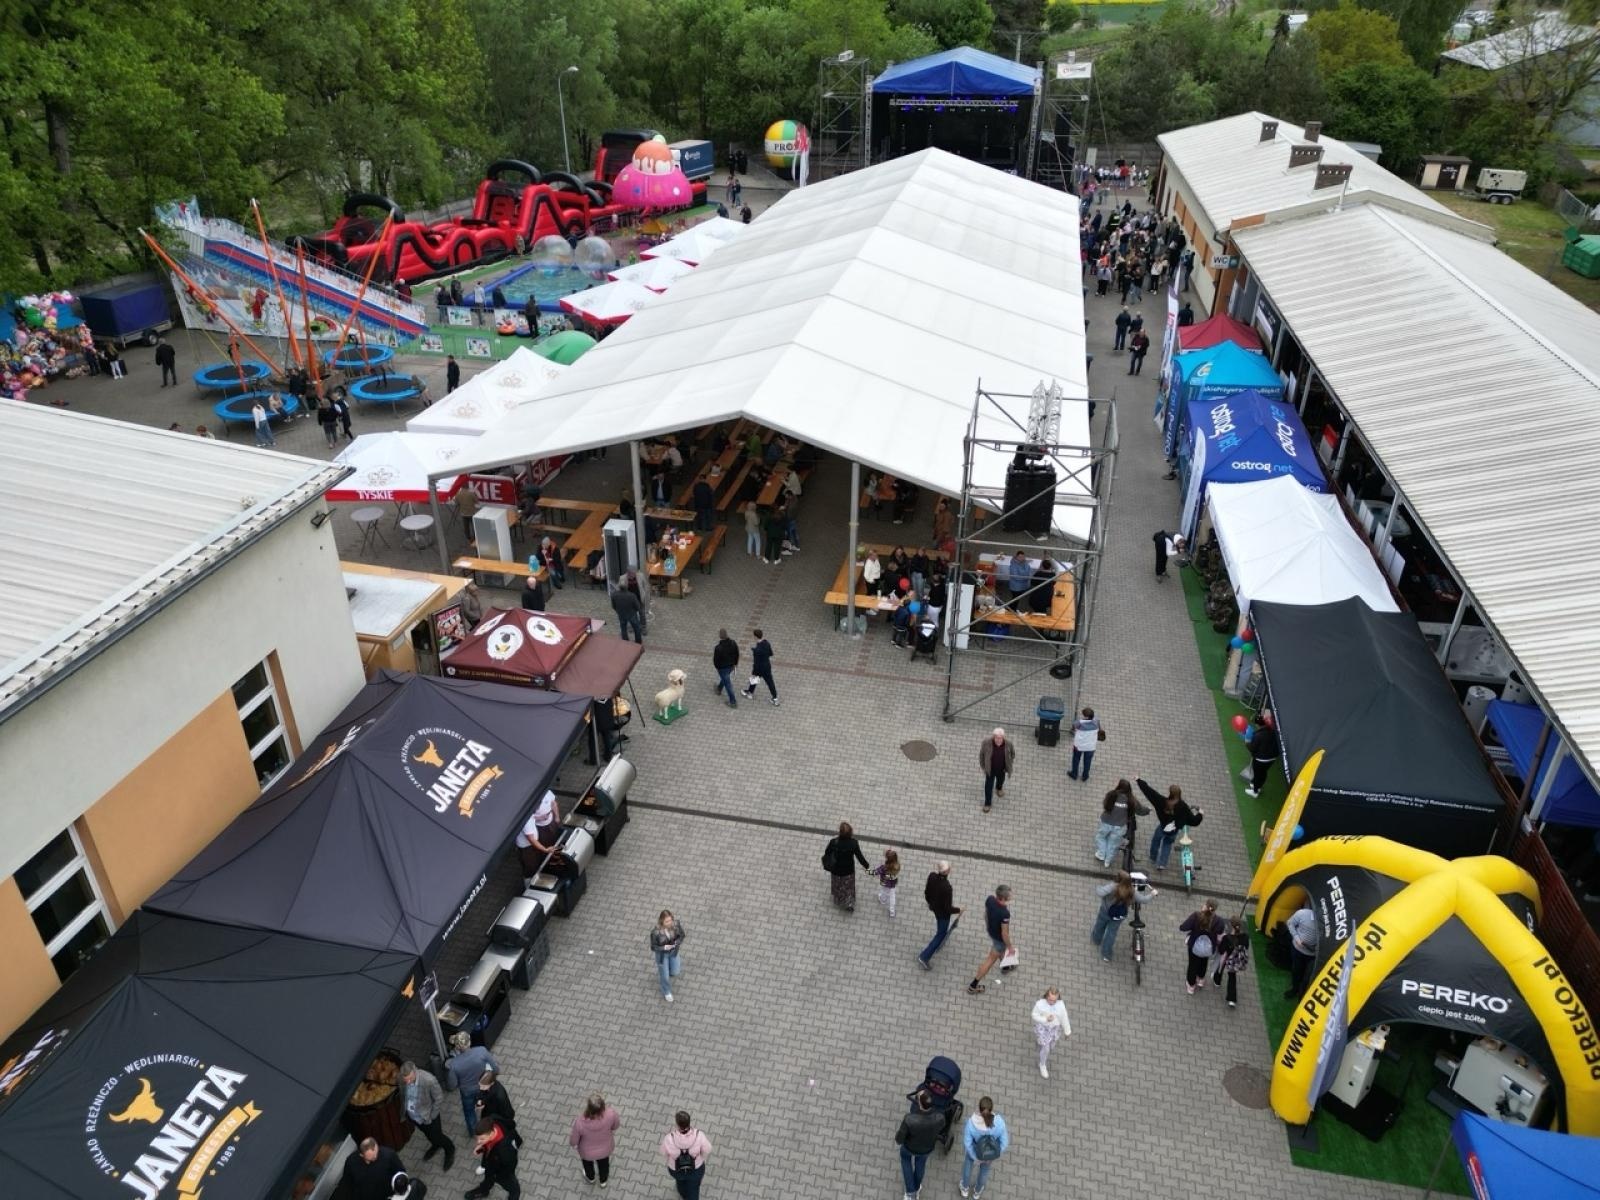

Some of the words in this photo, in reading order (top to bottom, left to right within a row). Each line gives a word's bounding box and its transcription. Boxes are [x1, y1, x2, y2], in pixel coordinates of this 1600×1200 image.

[1213, 256, 1228, 264] WC
[357, 490, 394, 500] TYSKIE
[426, 740, 493, 813] JANETA
[442, 872, 487, 941] www.janeta.pl
[1326, 875, 1347, 942] PEREKO
[1445, 1009, 1462, 1019] jest
[124, 1053, 200, 1074] WĘDLINIARSKI
[86, 1077, 118, 1132] RZEŹNICZO
[120, 1065, 248, 1200] JANETA
[187, 1116, 238, 1182] ERNESTYN
[86, 1138, 116, 1175] ZAKŁAD
[217, 1145, 236, 1167] 1989
